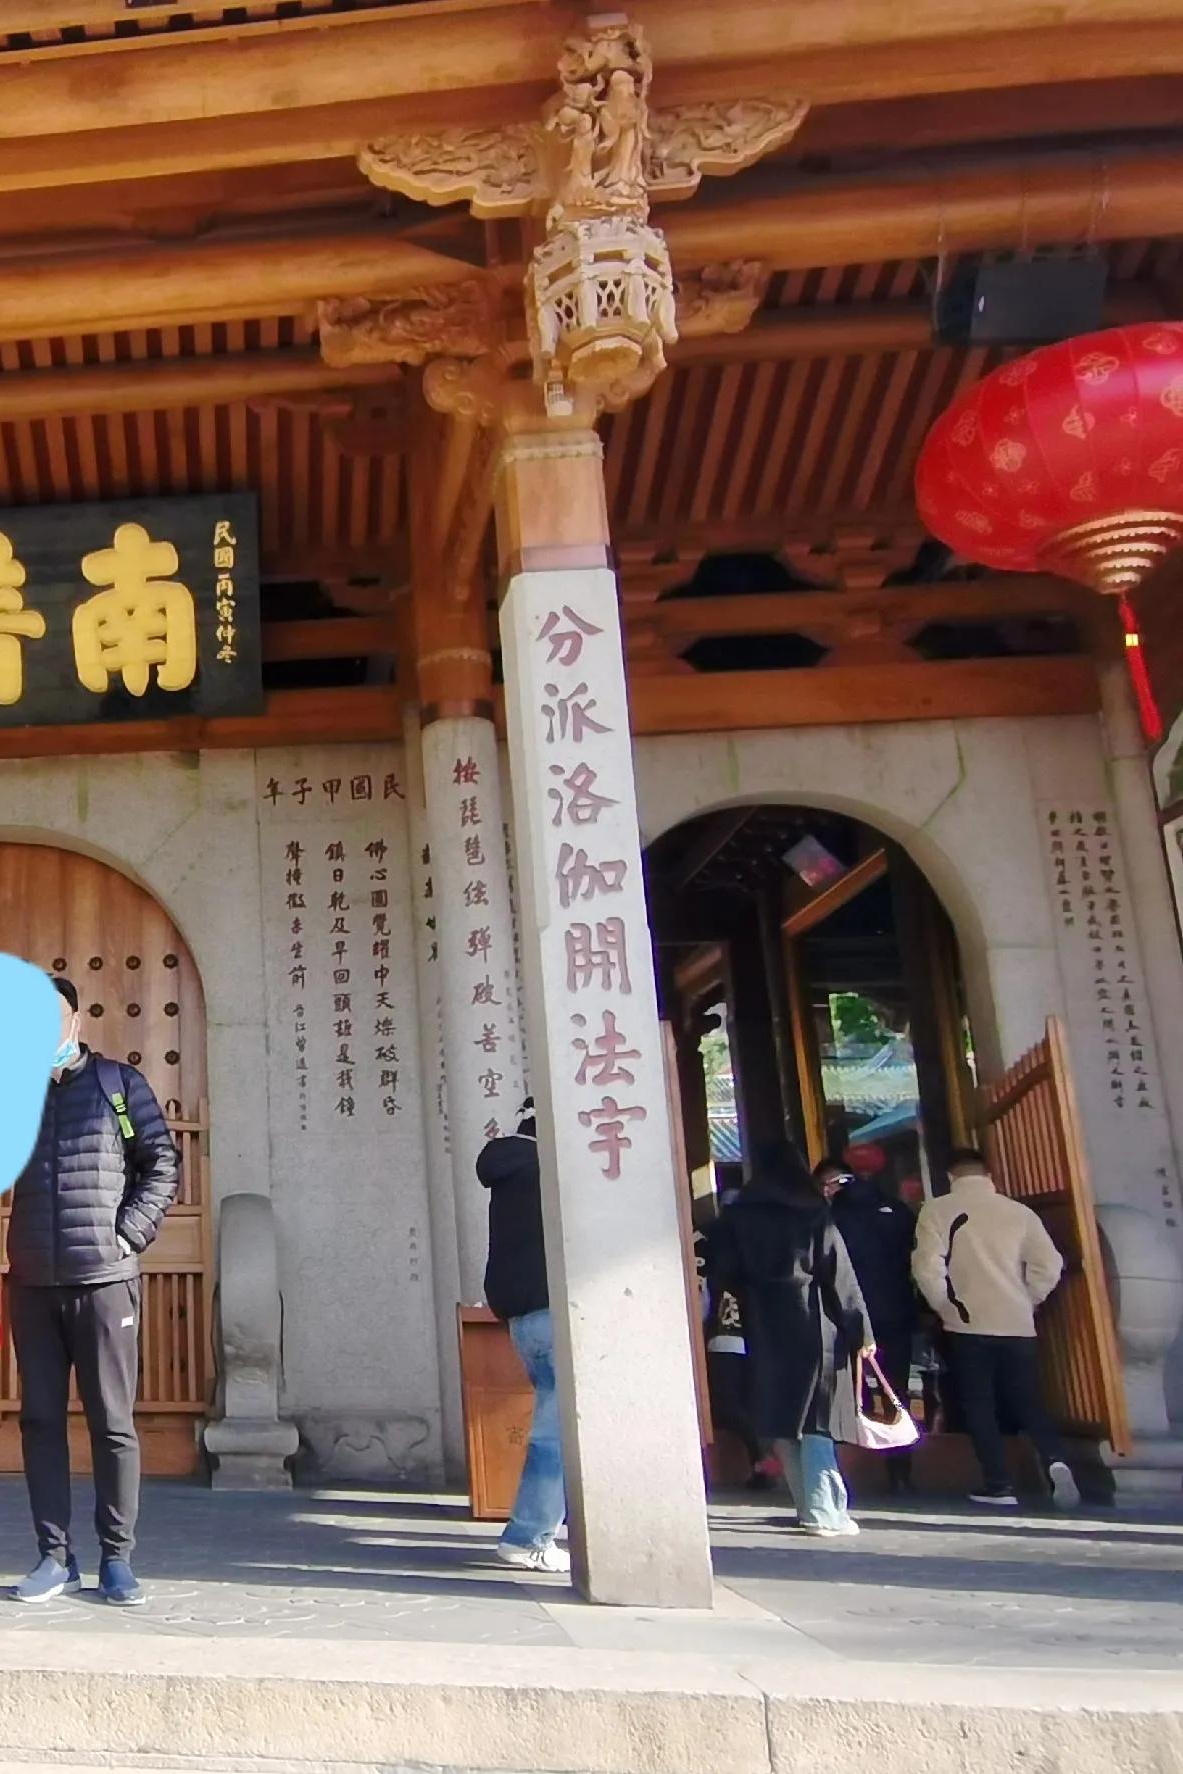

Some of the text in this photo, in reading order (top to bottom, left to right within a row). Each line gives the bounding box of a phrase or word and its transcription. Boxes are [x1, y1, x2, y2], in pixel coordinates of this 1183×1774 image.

[263, 773, 406, 806] 民國甲子年
[535, 604, 647, 1181] 分派洛伽開法宇
